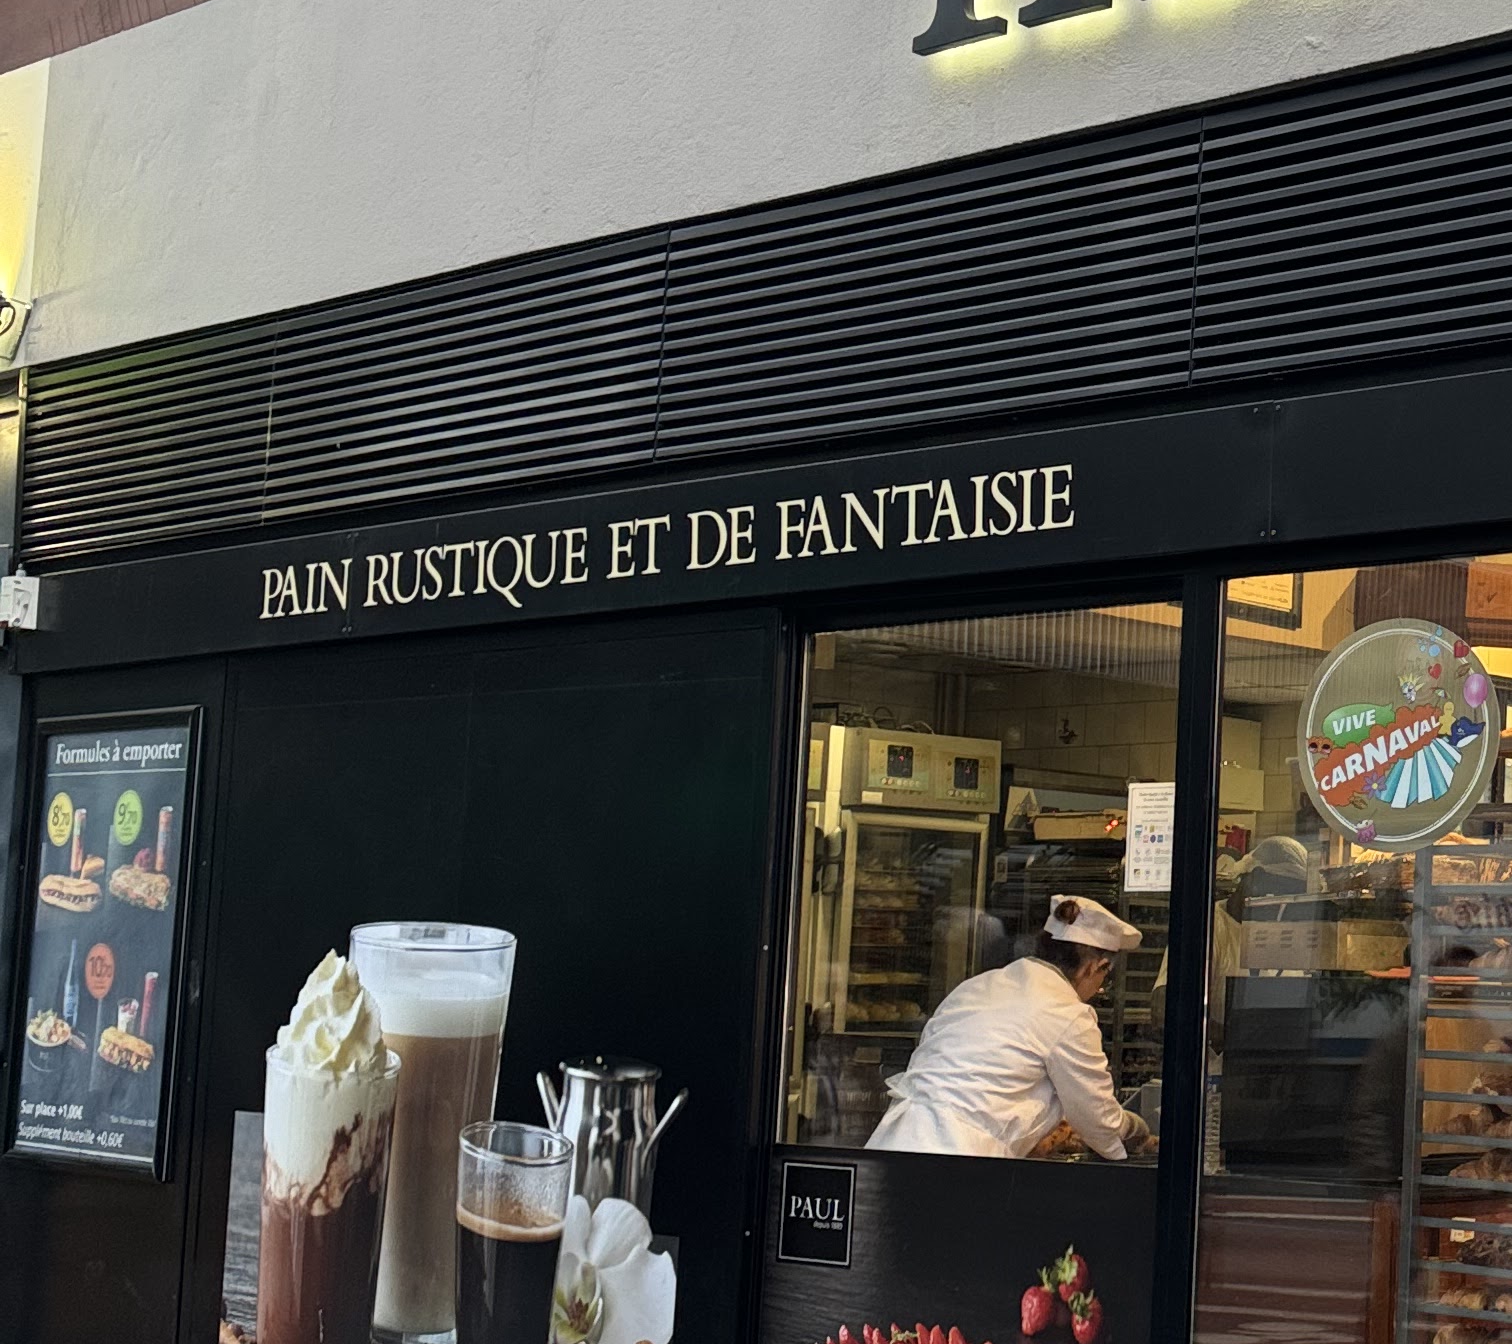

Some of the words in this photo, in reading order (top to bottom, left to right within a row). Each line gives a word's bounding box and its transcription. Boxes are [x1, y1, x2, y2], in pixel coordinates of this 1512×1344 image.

[258, 557, 352, 620] PAIN
[362, 529, 589, 609] RUSTIQUE
[606, 516, 671, 580] ET
[687, 506, 757, 571] DE
[774, 464, 1077, 561] FANTAISIE
[1332, 709, 1376, 736] VIVE
[55, 740, 111, 764] Formules
[112, 739, 120, 762] à
[123, 743, 183, 767] emporter
[1320, 716, 1441, 792] CARNAVAL
[20, 1099, 34, 1114] Sur
[35, 1101, 56, 1118] place
[62, 1127, 96, 1145] bouteille
[789, 1195, 845, 1221] PAUL
